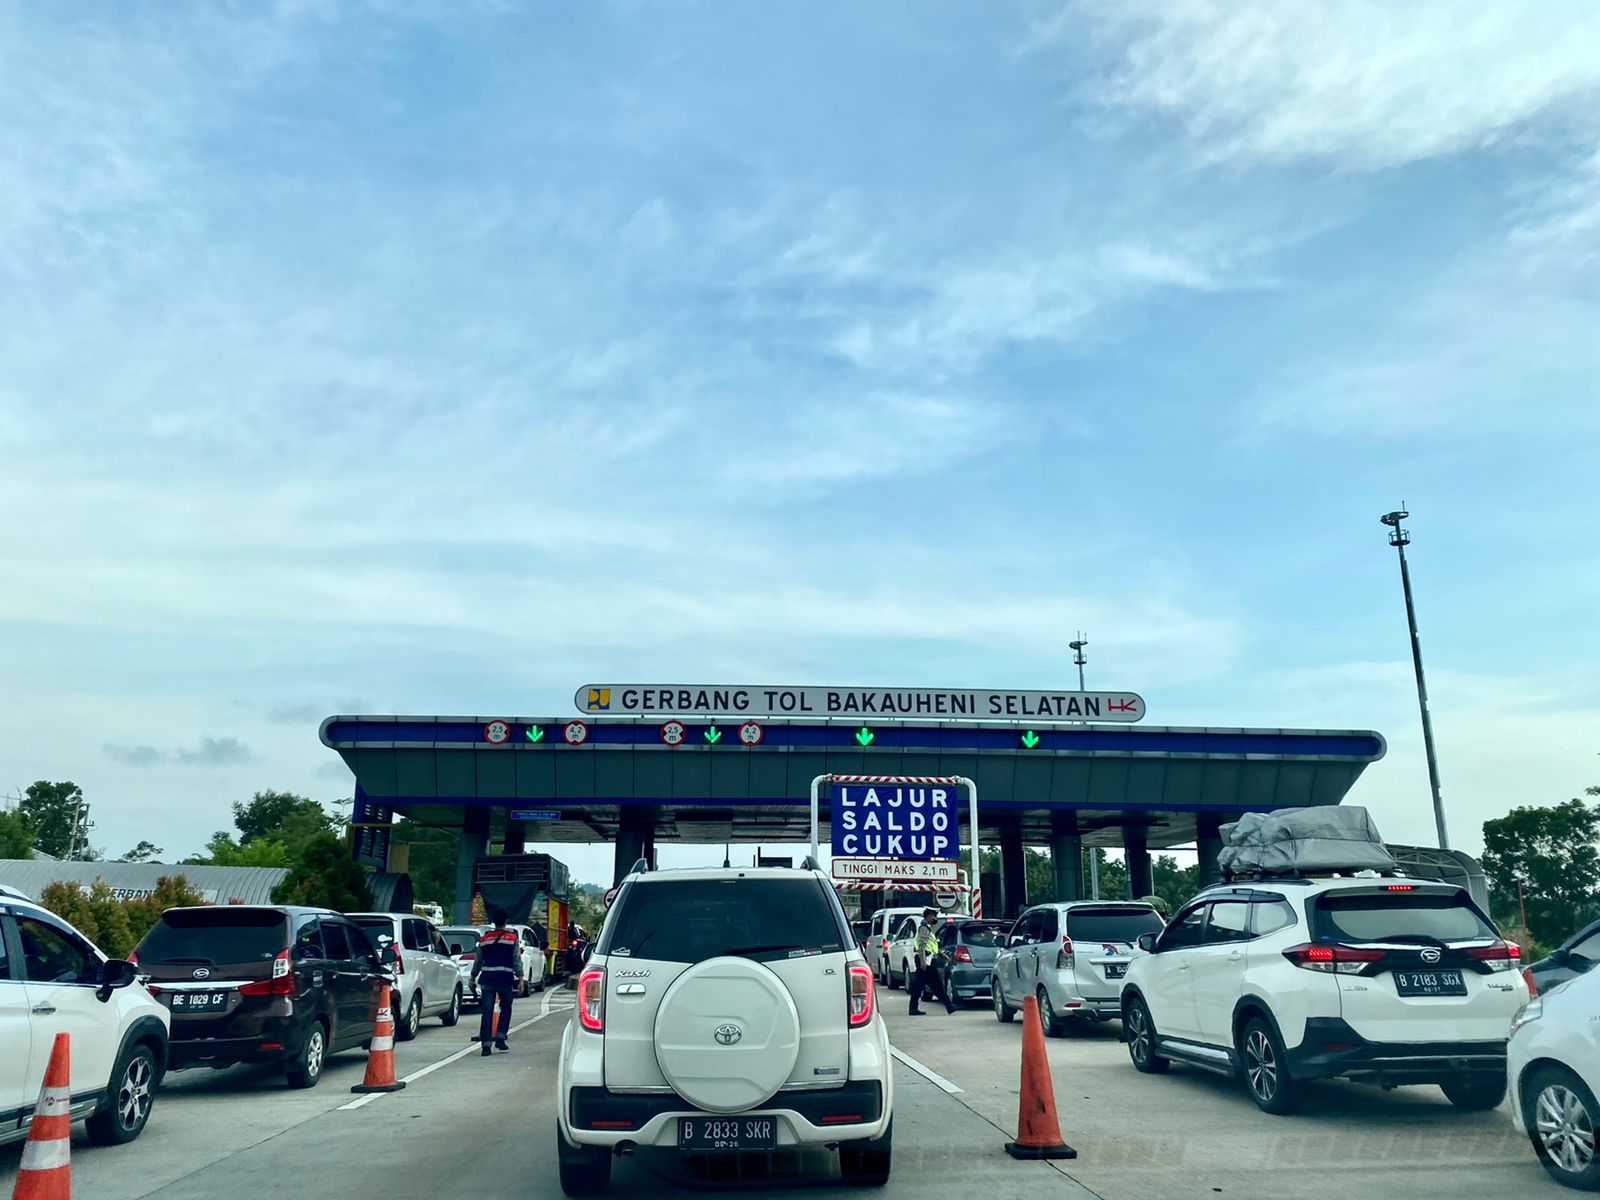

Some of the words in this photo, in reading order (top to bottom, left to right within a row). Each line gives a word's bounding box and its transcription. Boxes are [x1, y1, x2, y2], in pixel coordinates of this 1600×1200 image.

[622, 689, 750, 710] GERBANG
[764, 691, 813, 711] TOL
[827, 692, 975, 714] BAKAUHENI
[988, 695, 1100, 716] SELATAN
[842, 788, 948, 807] LAJUR
[842, 811, 948, 831] SALDO
[843, 834, 949, 855] CUKUP
[843, 864, 878, 874] TINGGI
[884, 865, 916, 875] MAKS
[939, 867, 949, 876] m
[615, 970, 652, 978] Rush
[1400, 974, 1408, 987] B
[1412, 973, 1438, 987] 2183
[172, 994, 185, 1006] BE
[189, 993, 209, 1005] 1029
[212, 993, 225, 1005] CF
[684, 1121, 694, 1139] B
[704, 1121, 739, 1139] 2833
[745, 1121, 771, 1138] SKR
